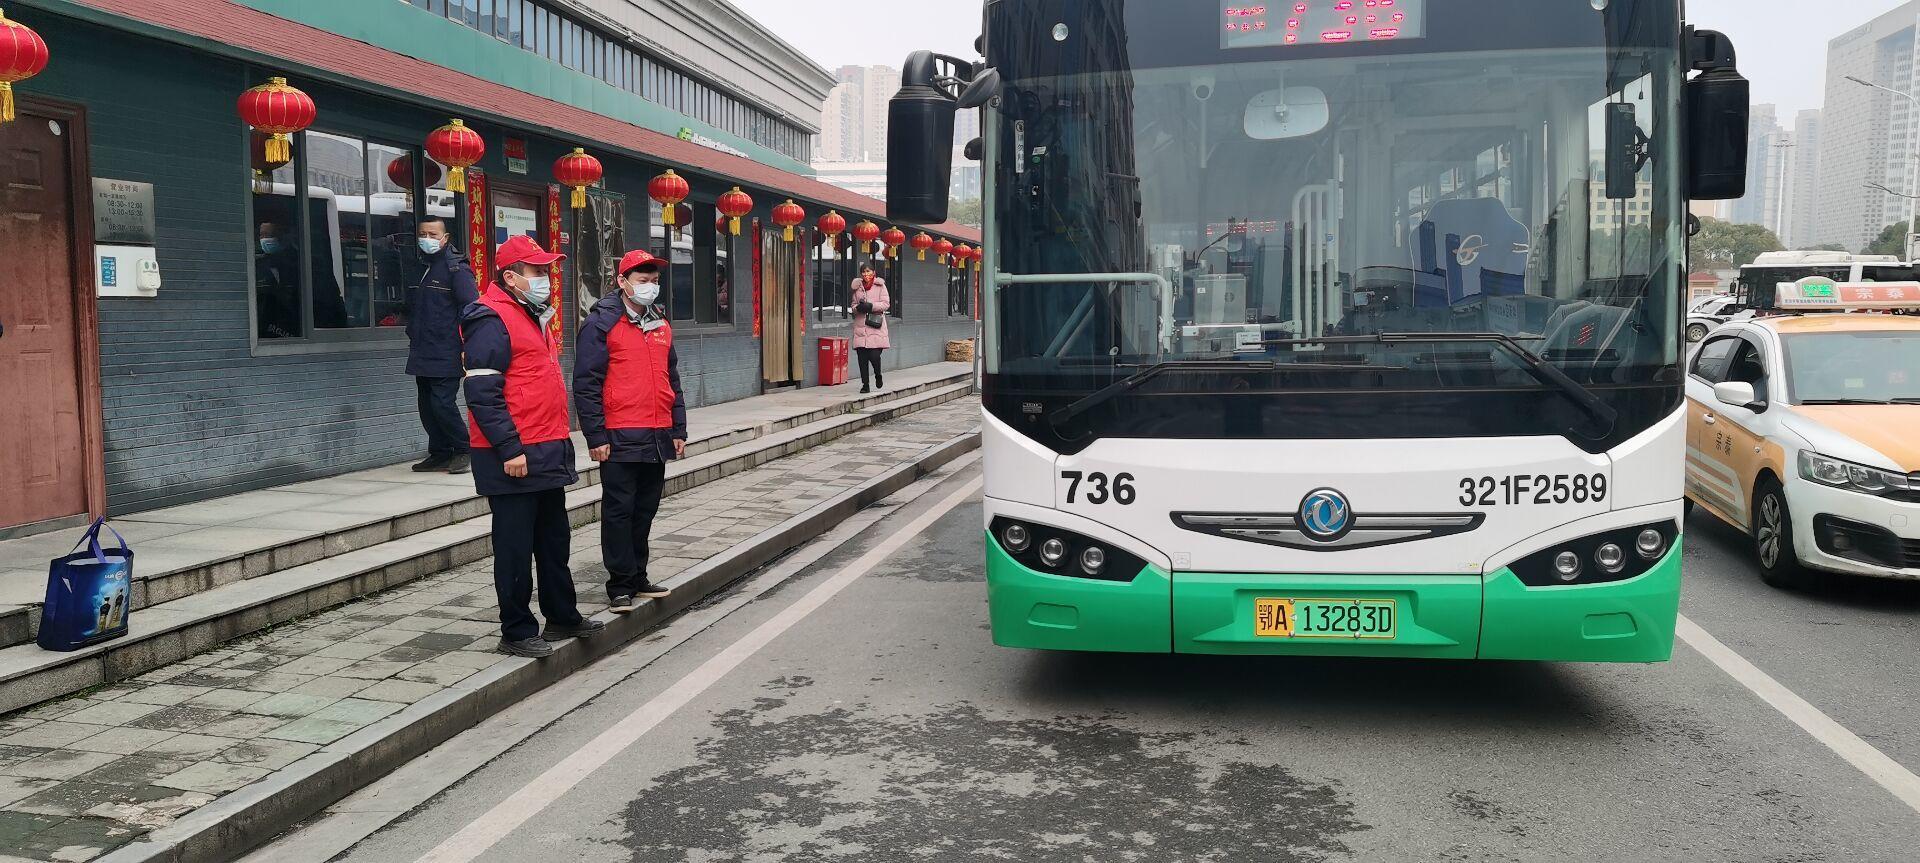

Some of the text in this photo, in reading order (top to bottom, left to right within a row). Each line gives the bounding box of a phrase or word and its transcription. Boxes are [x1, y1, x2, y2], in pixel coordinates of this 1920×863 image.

[110, 183, 139, 193] 营业时间
[1061, 470, 1136, 506] 736
[1459, 472, 1607, 507] 321F2589
[1259, 604, 1392, 632] 鄂A 13283D
